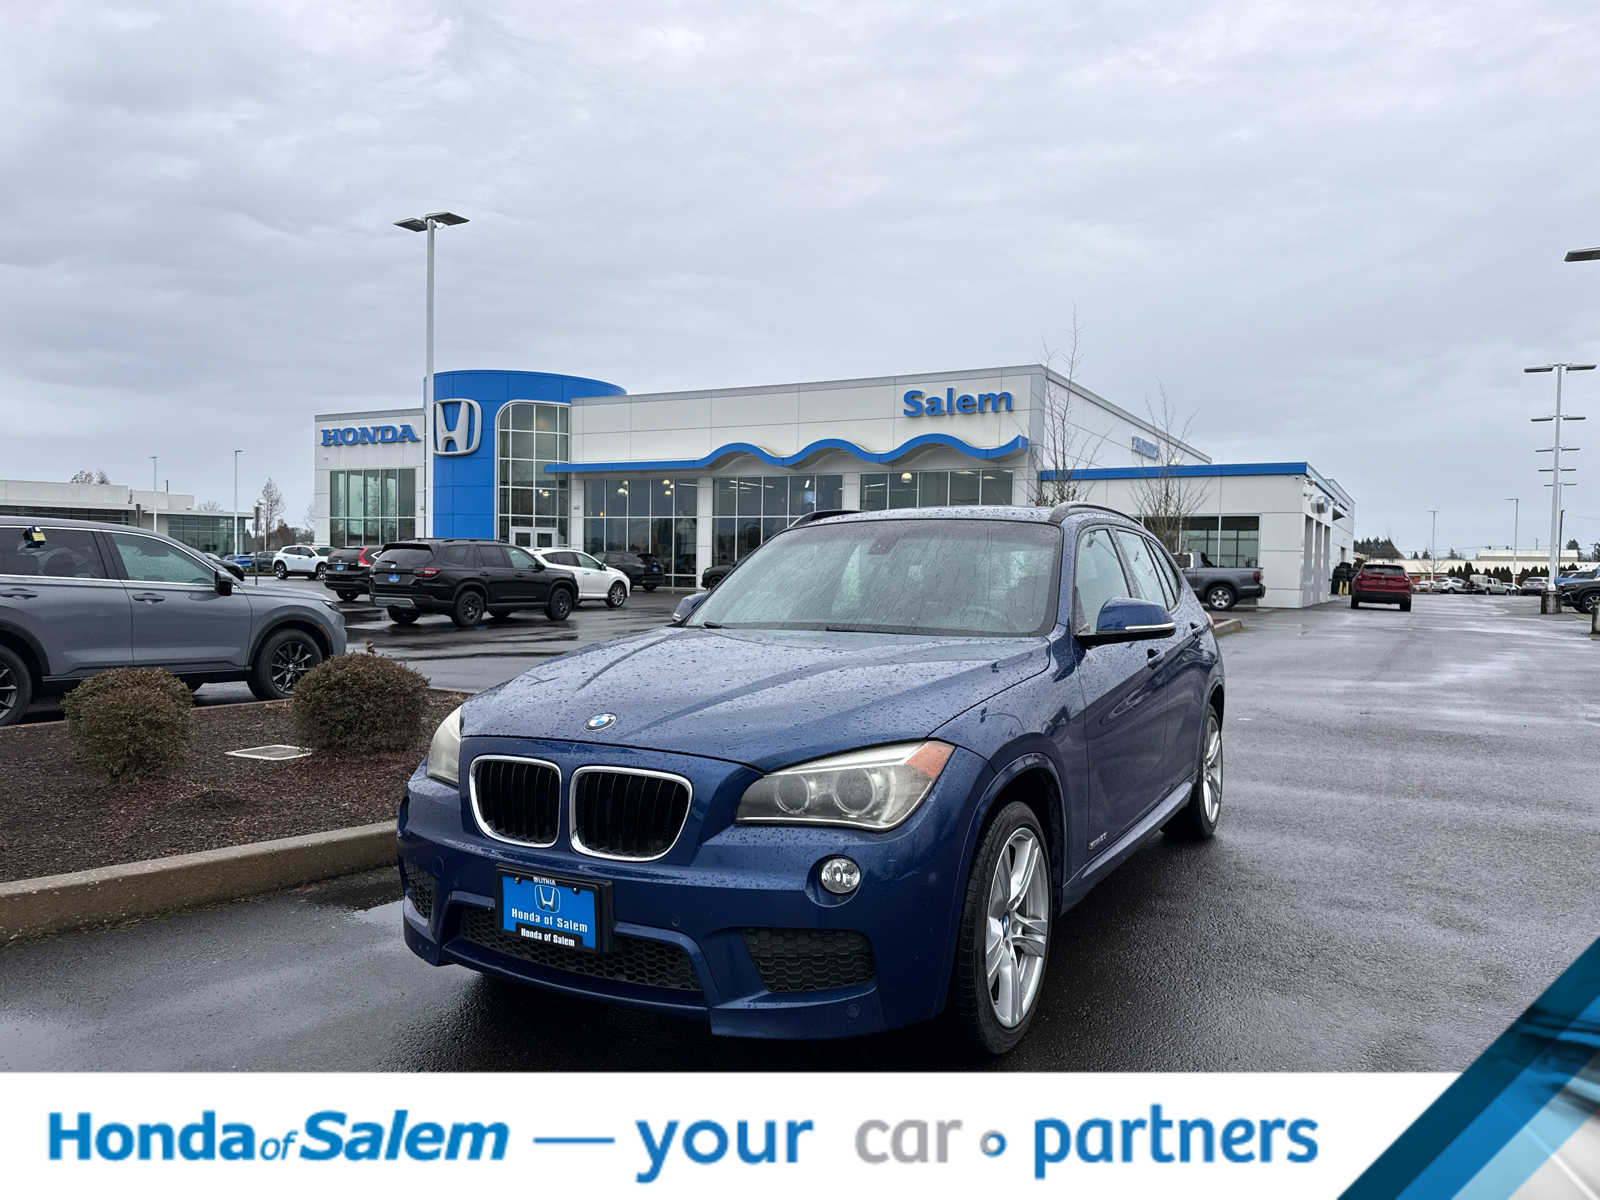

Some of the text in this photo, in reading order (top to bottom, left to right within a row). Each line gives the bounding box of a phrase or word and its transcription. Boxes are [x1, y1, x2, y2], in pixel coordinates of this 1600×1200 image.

[903, 387, 1013, 417] Salem
[320, 423, 421, 447] HONDA
[511, 907, 588, 933] Honda of Salem
[521, 927, 575, 947] Honda of Salem
